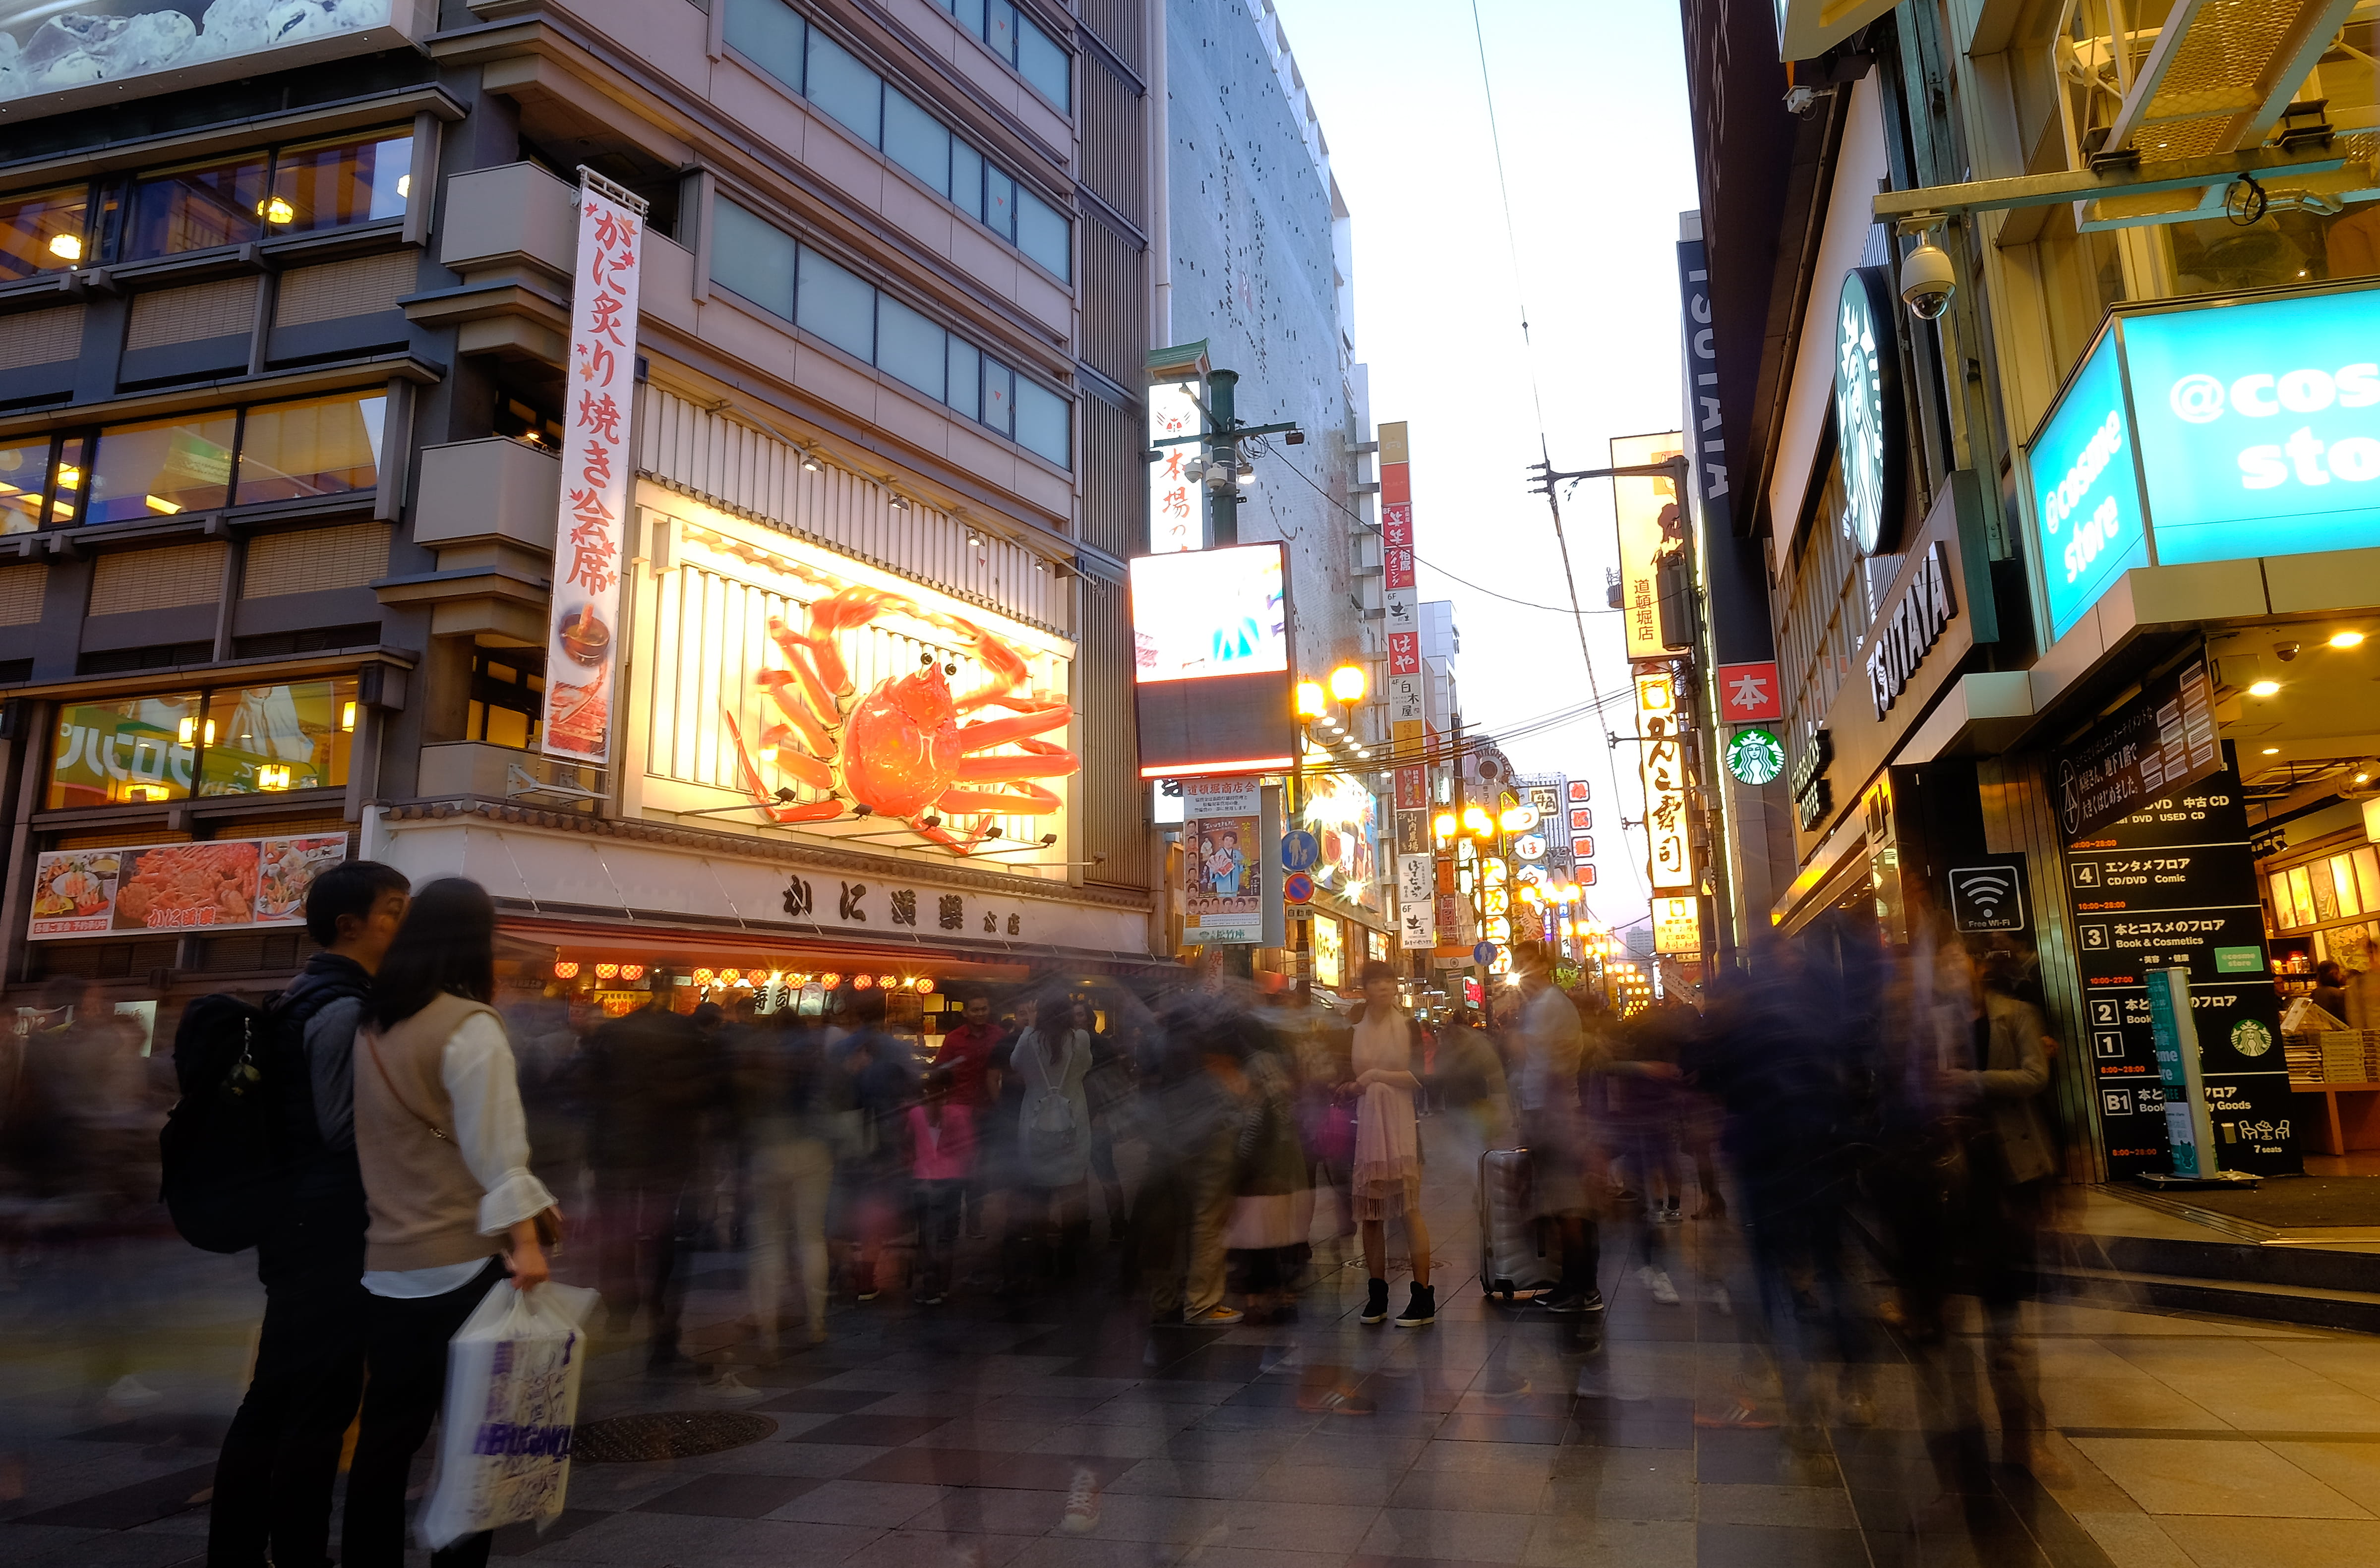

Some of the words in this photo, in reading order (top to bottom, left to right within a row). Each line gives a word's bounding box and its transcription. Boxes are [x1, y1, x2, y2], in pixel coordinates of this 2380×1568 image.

[2045, 410, 2122, 534] @cosme
[1160, 448, 1190, 551] 本場の
[2064, 495, 2119, 583] store
[1634, 579, 1654, 640] 道頓堀店
[1866, 540, 1951, 722] TSUTAYA
[1392, 635, 1415, 672] はや
[1401, 681, 1419, 717] 白木屋
[1729, 675, 1768, 710] 本
[1188, 782, 1255, 795] 道頓堀商店会
[1647, 712, 1684, 871] がんこ寿司
[2082, 775, 2139, 821] 大きくはじめました。
[2183, 797, 2207, 809] 中古
[2209, 796, 2229, 807] CD
[2132, 814, 2153, 823] DVD
[2159, 813, 2187, 821] USED
[1407, 813, 1419, 852] 山内農場
[2105, 858, 2191, 872] エンタメフロア
[2079, 868, 2093, 883] 4
[2107, 876, 2147, 885] CD/DVD
[2154, 874, 2186, 883] Comic
[1288, 909, 1312, 917] 自動車
[2114, 919, 2226, 935] 本とコスメのフロア
[2087, 929, 2102, 945] 3
[2116, 938, 2142, 948] Book
[2152, 936, 2203, 946] Cosmetics
[754, 985, 790, 1010] 寿司
[2098, 1004, 2112, 1021] 2
[2103, 1036, 2113, 1053] 1
[2107, 1094, 2129, 1110] B1
[2217, 1101, 2252, 1110] Goods
[2254, 1145, 2261, 1153] 7
